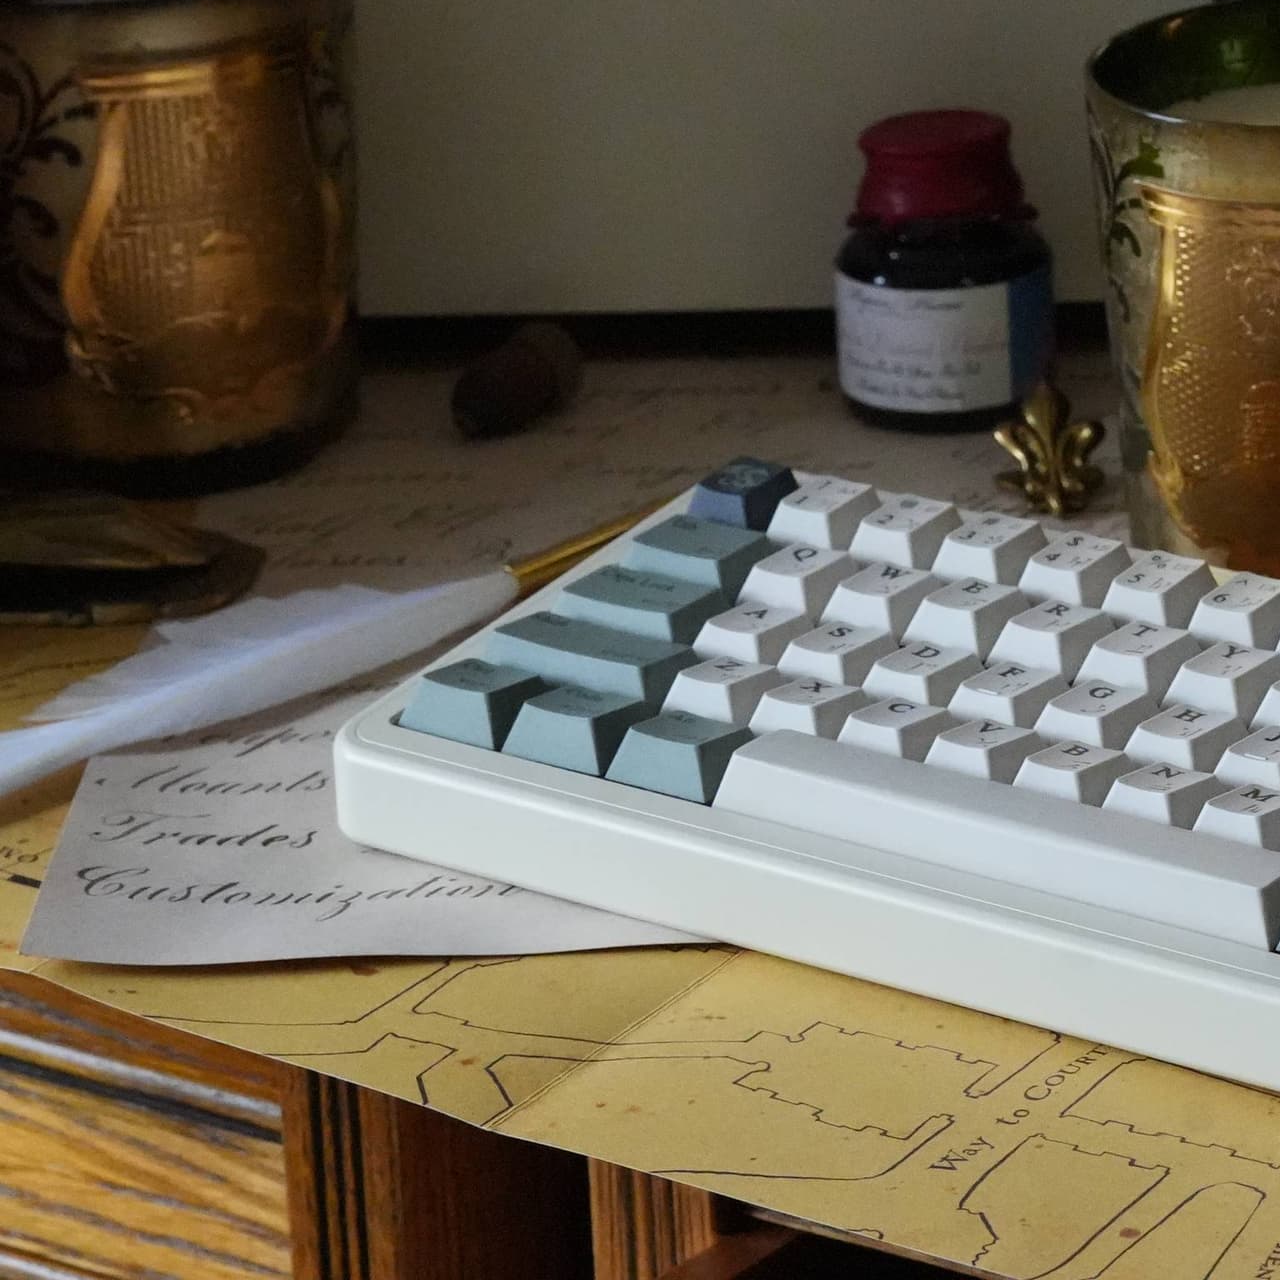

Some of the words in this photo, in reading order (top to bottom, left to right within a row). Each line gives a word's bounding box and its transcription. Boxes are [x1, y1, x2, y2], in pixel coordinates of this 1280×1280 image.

[89, 809, 319, 849] Trades
[928, 1136, 996, 1171] Way
[995, 1108, 1031, 1125] to
